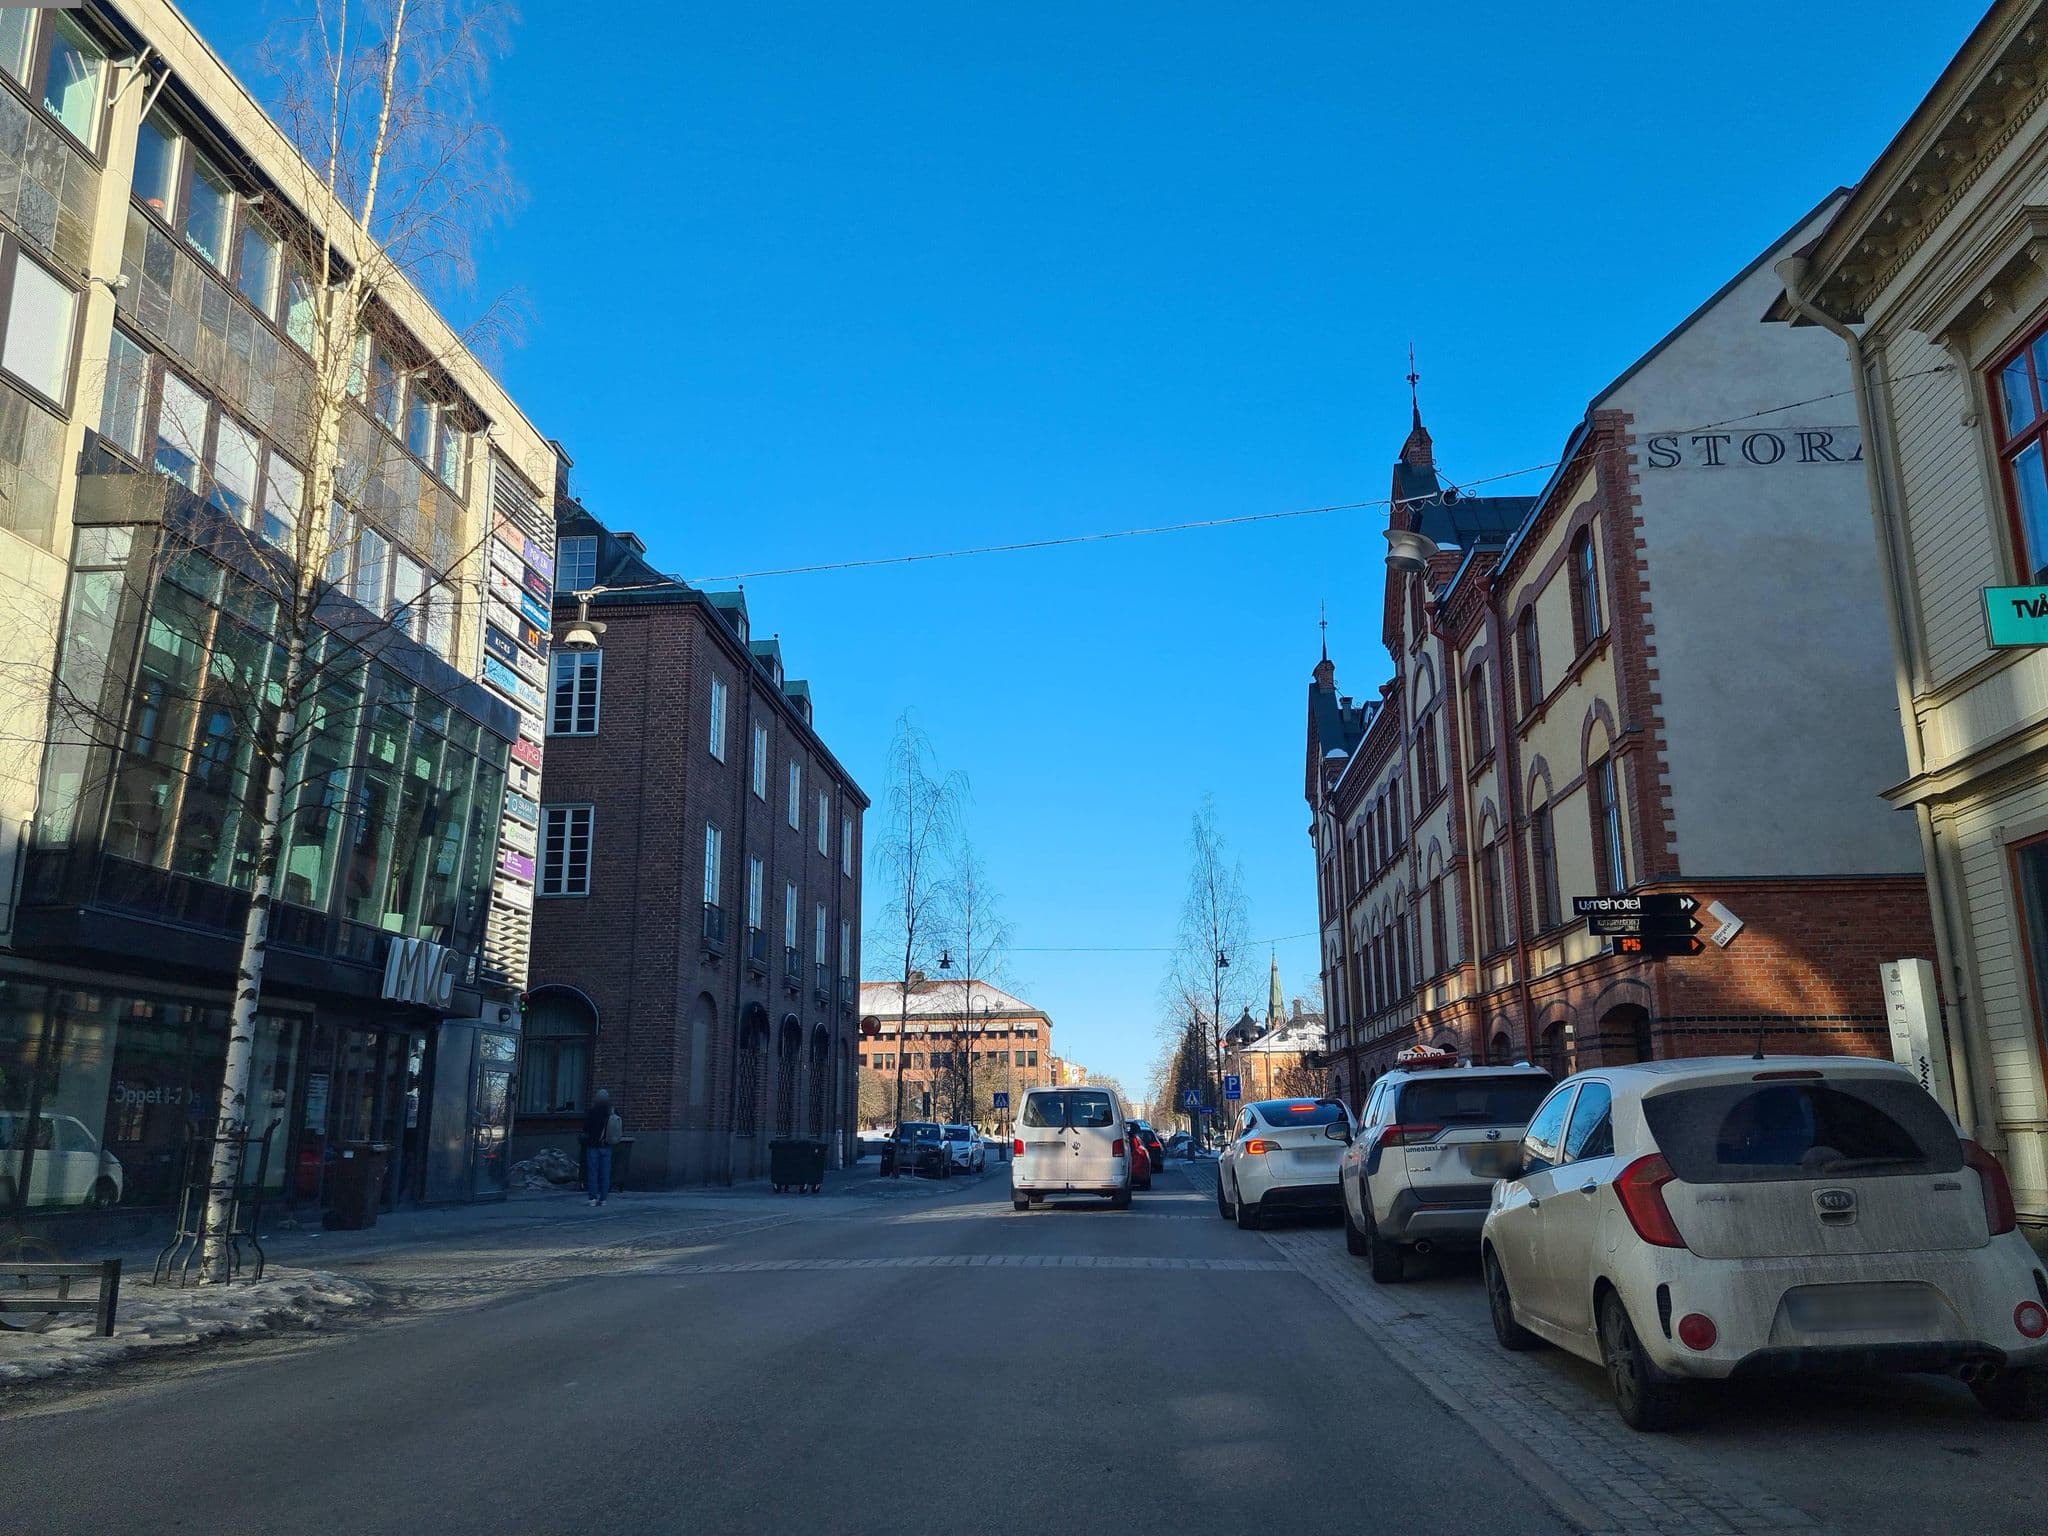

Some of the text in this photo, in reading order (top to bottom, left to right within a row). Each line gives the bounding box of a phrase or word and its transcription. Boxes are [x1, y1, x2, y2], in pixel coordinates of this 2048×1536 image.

[1646, 430, 1864, 469] STOR
[2011, 592, 2048, 619] TVÅ
[1228, 1077, 1238, 1090] P
[1822, 1195, 1849, 1207] KIA
